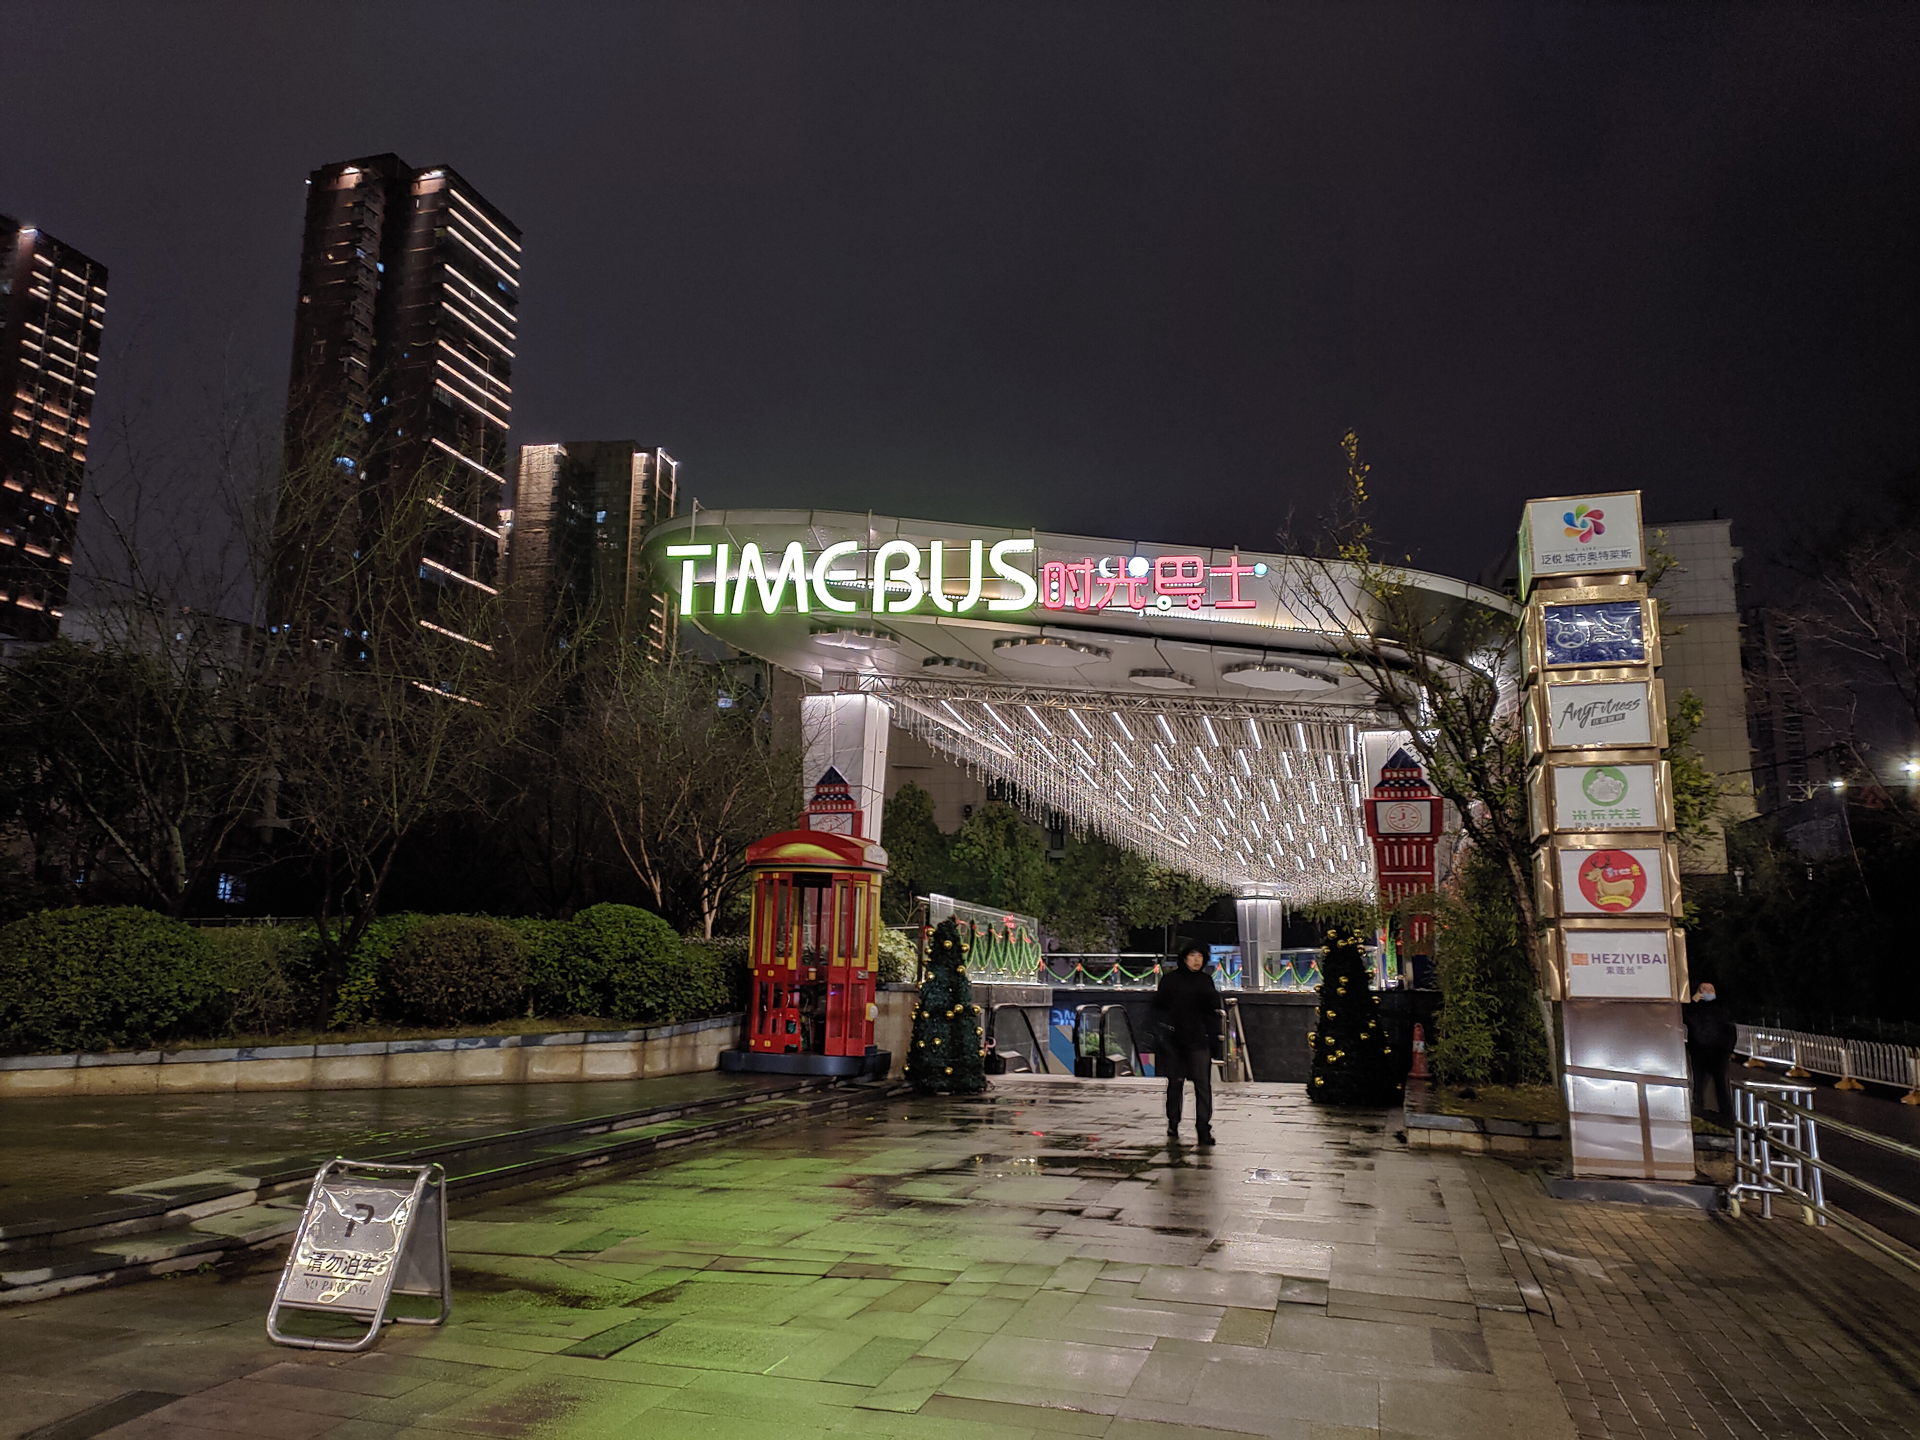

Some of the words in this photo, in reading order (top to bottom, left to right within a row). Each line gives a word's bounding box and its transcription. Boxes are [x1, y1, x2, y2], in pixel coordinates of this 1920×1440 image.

[1042, 554, 1267, 612] 时光巴士
[1591, 953, 1667, 964] HEZIYIBAI
[306, 1251, 379, 1277] 请勿泊车
[305, 1278, 319, 1291] NO
